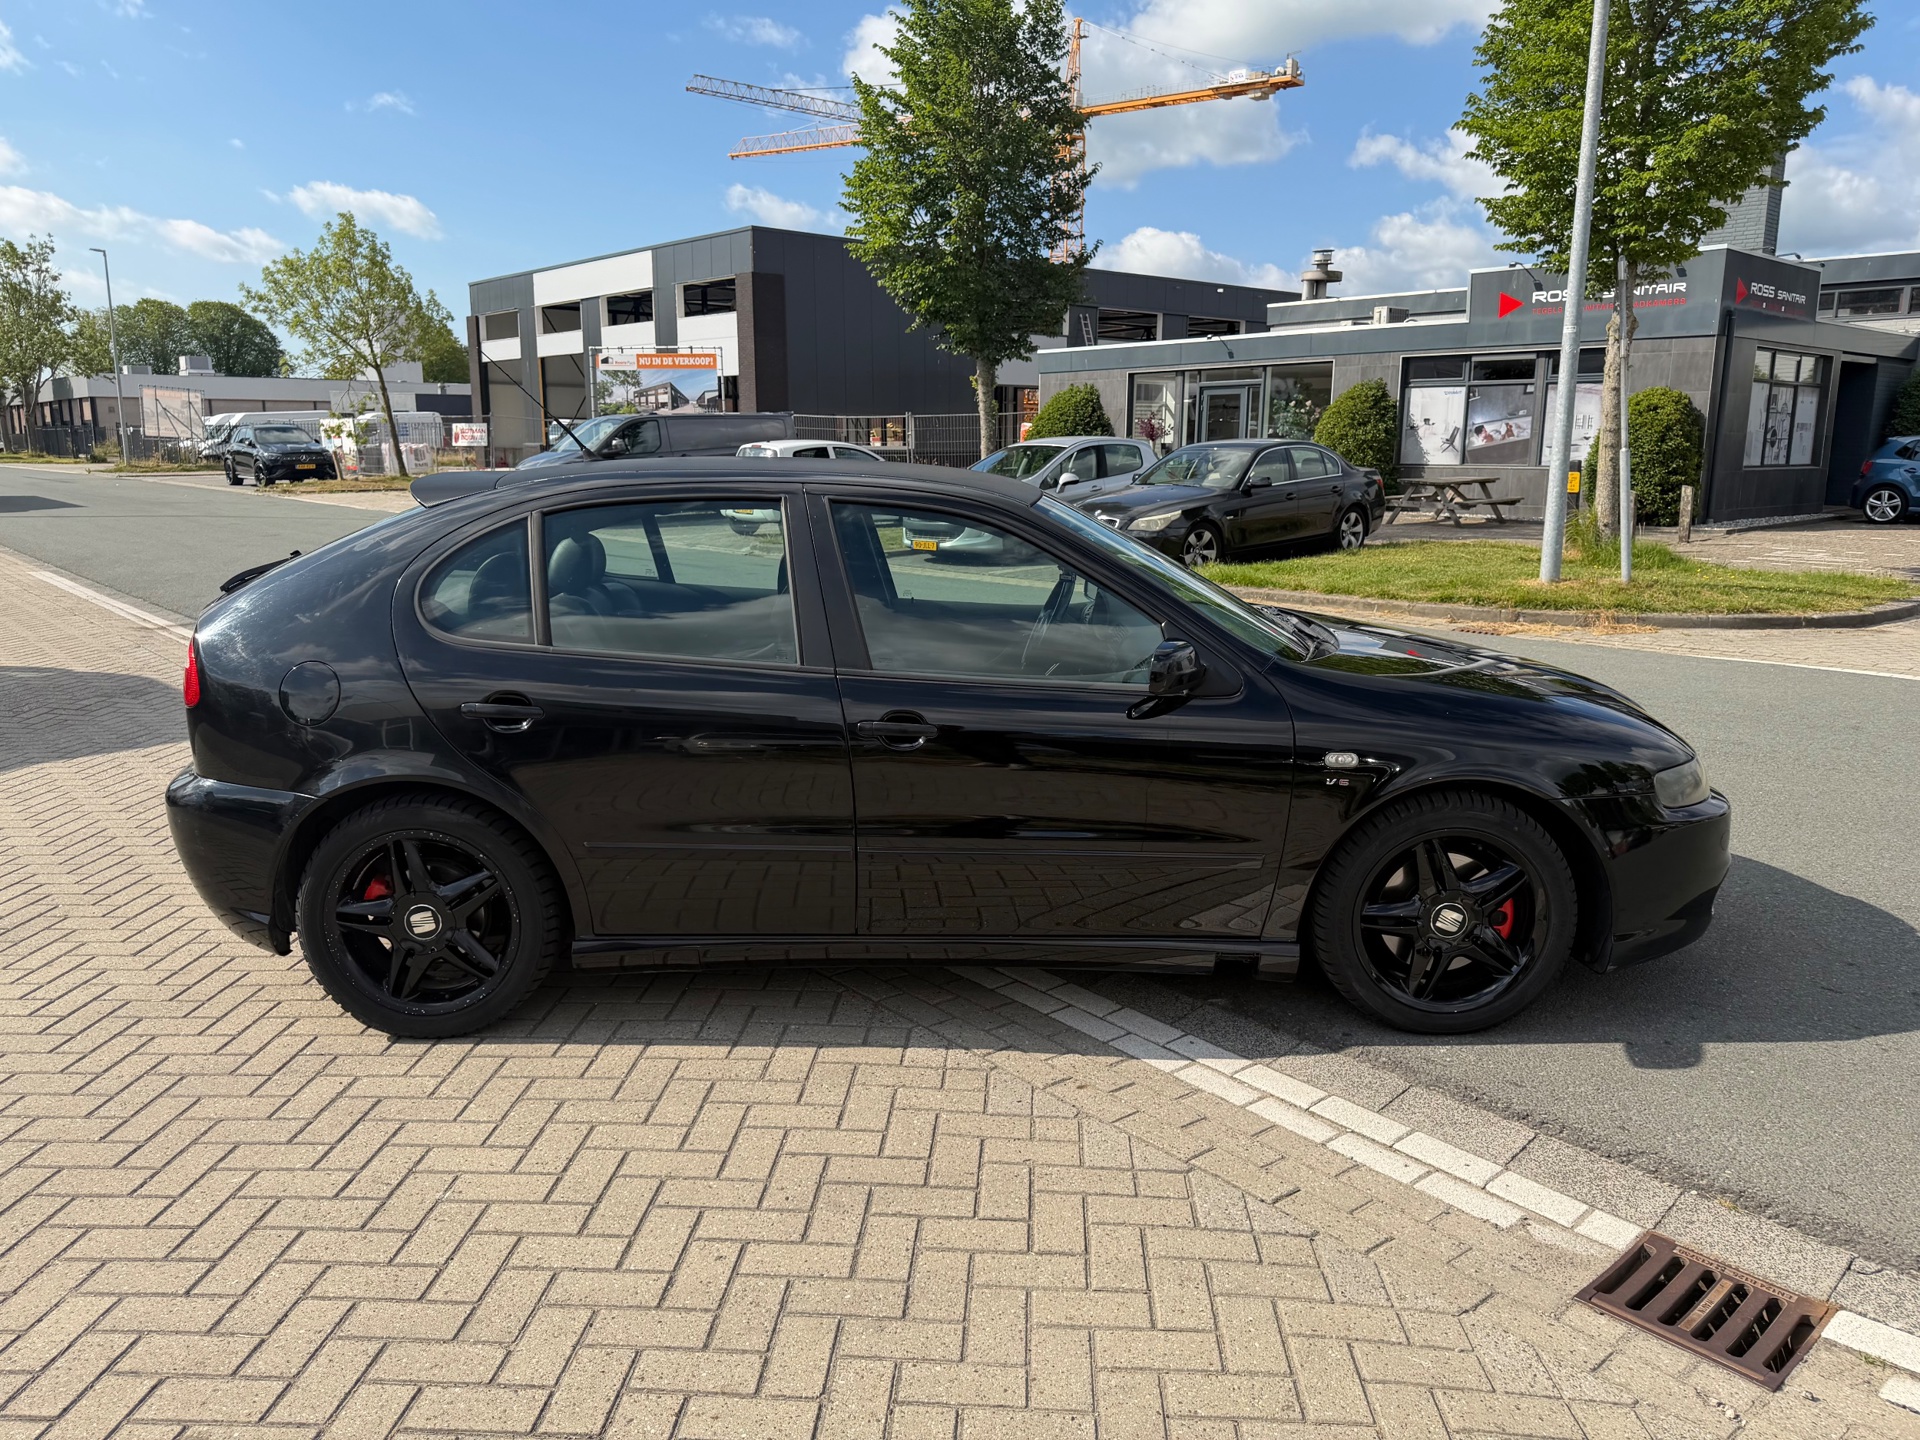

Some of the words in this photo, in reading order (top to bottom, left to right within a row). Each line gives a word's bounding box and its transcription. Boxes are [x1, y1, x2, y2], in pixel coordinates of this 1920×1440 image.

[1532, 289, 1568, 303] RO
[1602, 282, 1687, 299] SNITAIR
[1750, 282, 1776, 298] ROSS
[1777, 290, 1806, 305] SANITAIR
[1633, 297, 1687, 309] ADKAMERS
[639, 357, 651, 366] NU
[652, 357, 661, 366] IN
[662, 357, 674, 366] DE
[674, 356, 714, 366] VERKOOP!
